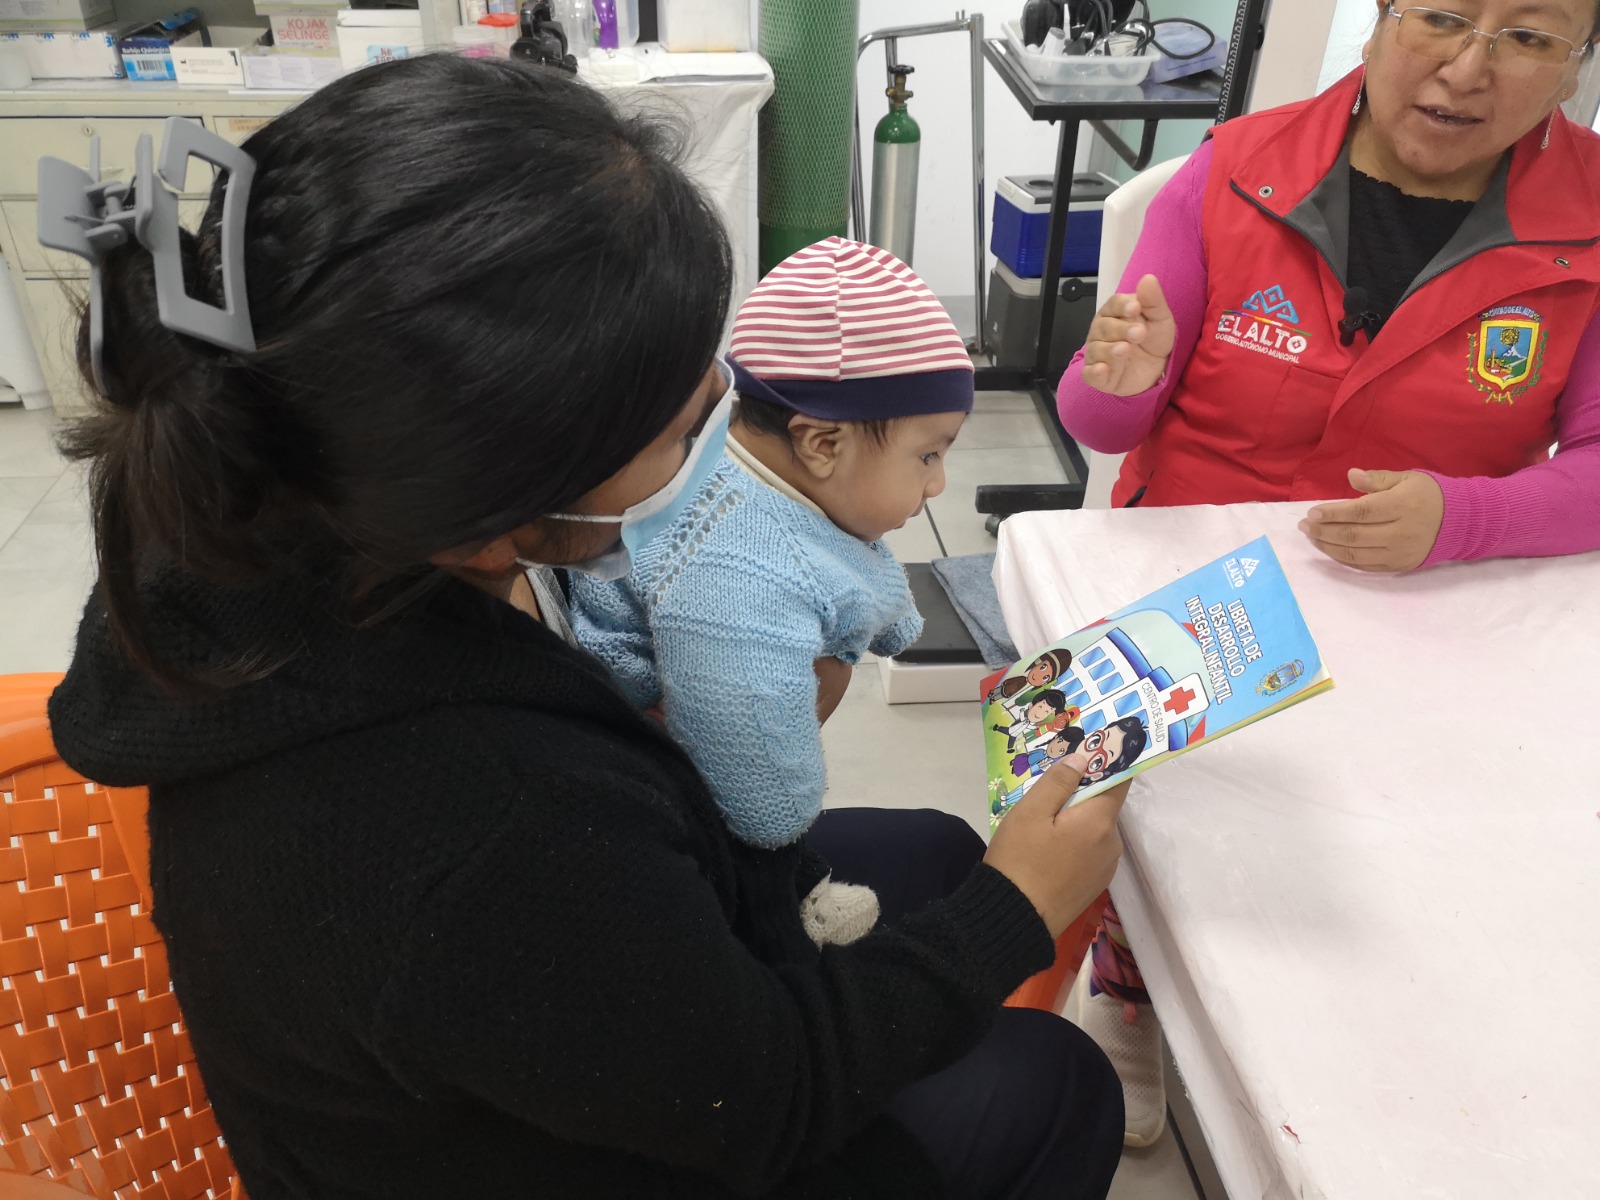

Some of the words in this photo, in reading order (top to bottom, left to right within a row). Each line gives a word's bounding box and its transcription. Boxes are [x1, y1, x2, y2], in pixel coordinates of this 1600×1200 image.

[278, 29, 329, 41] SELINGE
[287, 19, 327, 29] KOJAK
[1217, 314, 1243, 337] EL
[1243, 321, 1307, 354] ALTO
[1268, 348, 1300, 364] MUNICIPAL
[1225, 557, 1237, 570] EL
[1228, 567, 1245, 588] ALTO
[1207, 601, 1246, 678] DESARROLLO
[1226, 598, 1256, 648] LIBRETA
[1243, 642, 1263, 664] DE
[1185, 595, 1217, 654] INTEGRAL
[1203, 648, 1233, 705] INFANTIL
[1141, 682, 1160, 709] CENTRO
[1152, 707, 1162, 719] DE
[1154, 717, 1166, 743] SALUD
